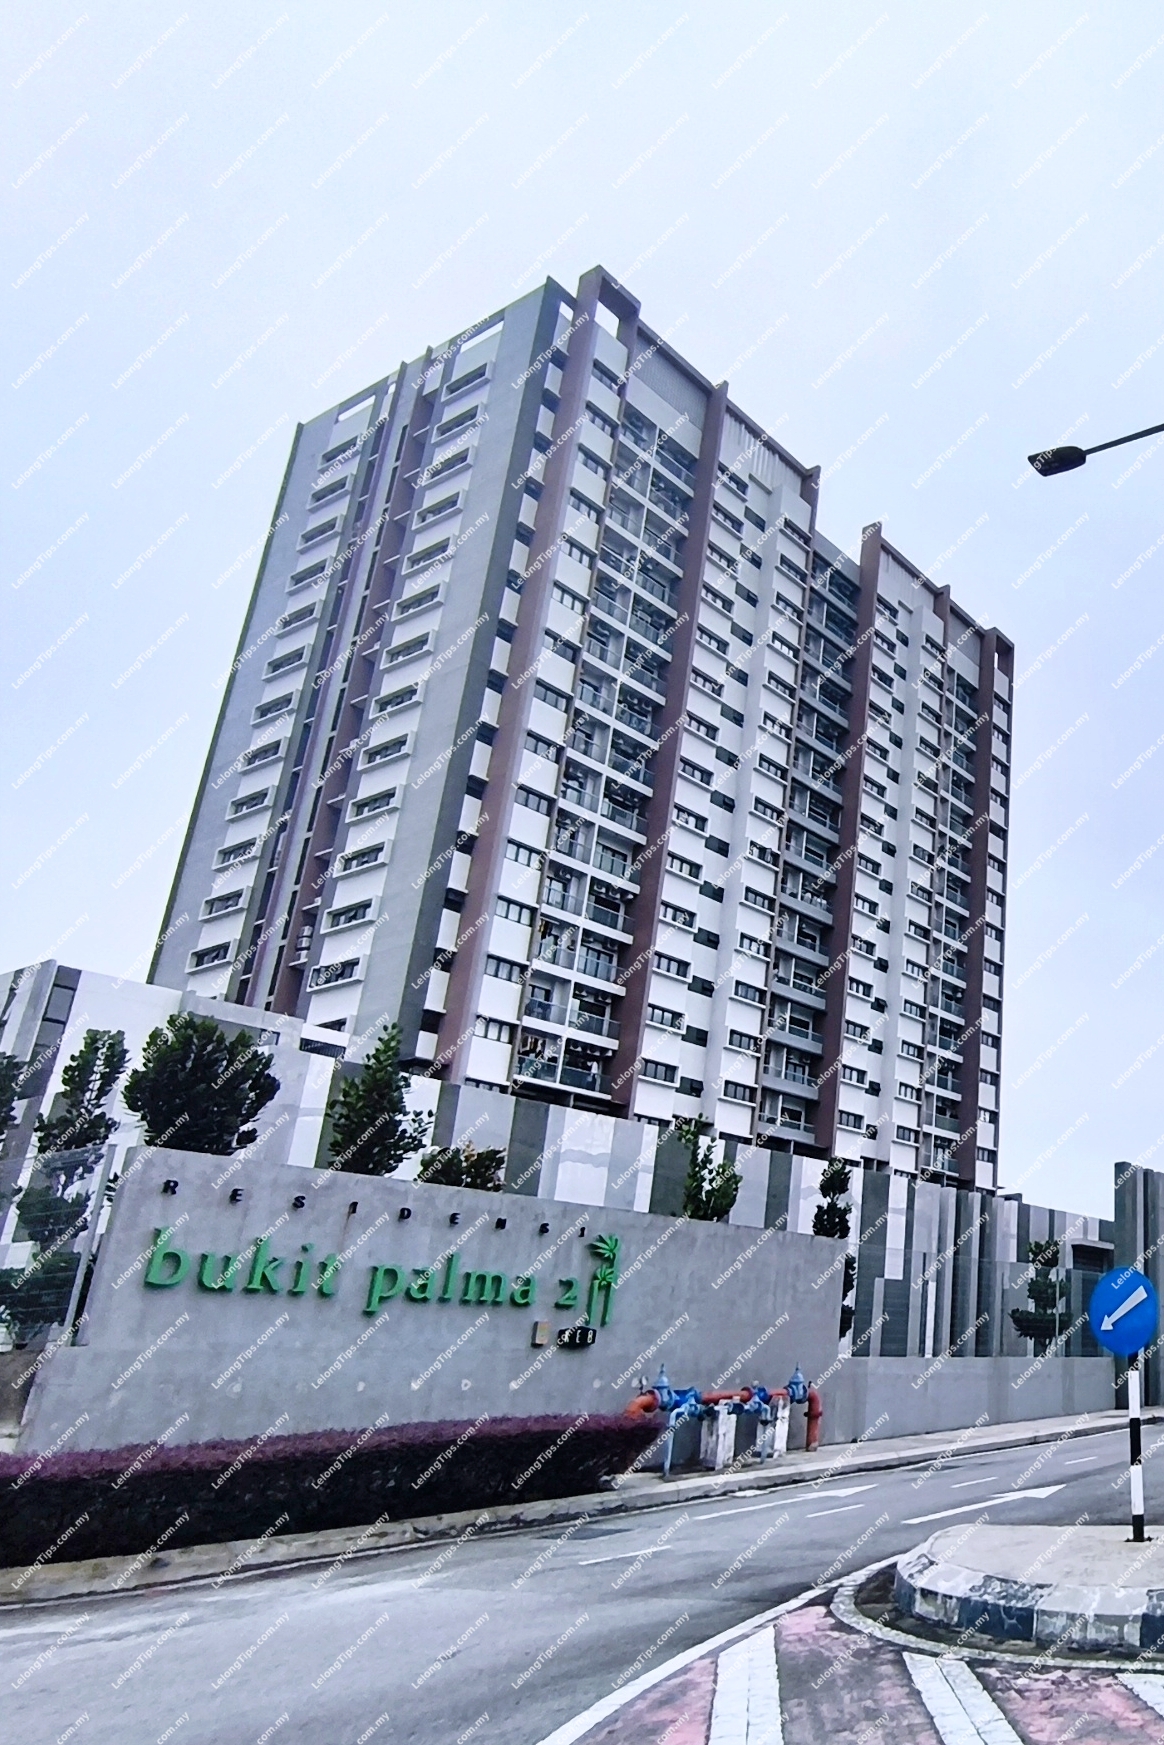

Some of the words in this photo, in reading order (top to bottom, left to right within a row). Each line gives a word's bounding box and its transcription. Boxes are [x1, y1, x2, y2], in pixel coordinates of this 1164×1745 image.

[144, 1226, 340, 1297] bukit
[362, 1252, 537, 1315] palma
[554, 1277, 580, 1309] 2
